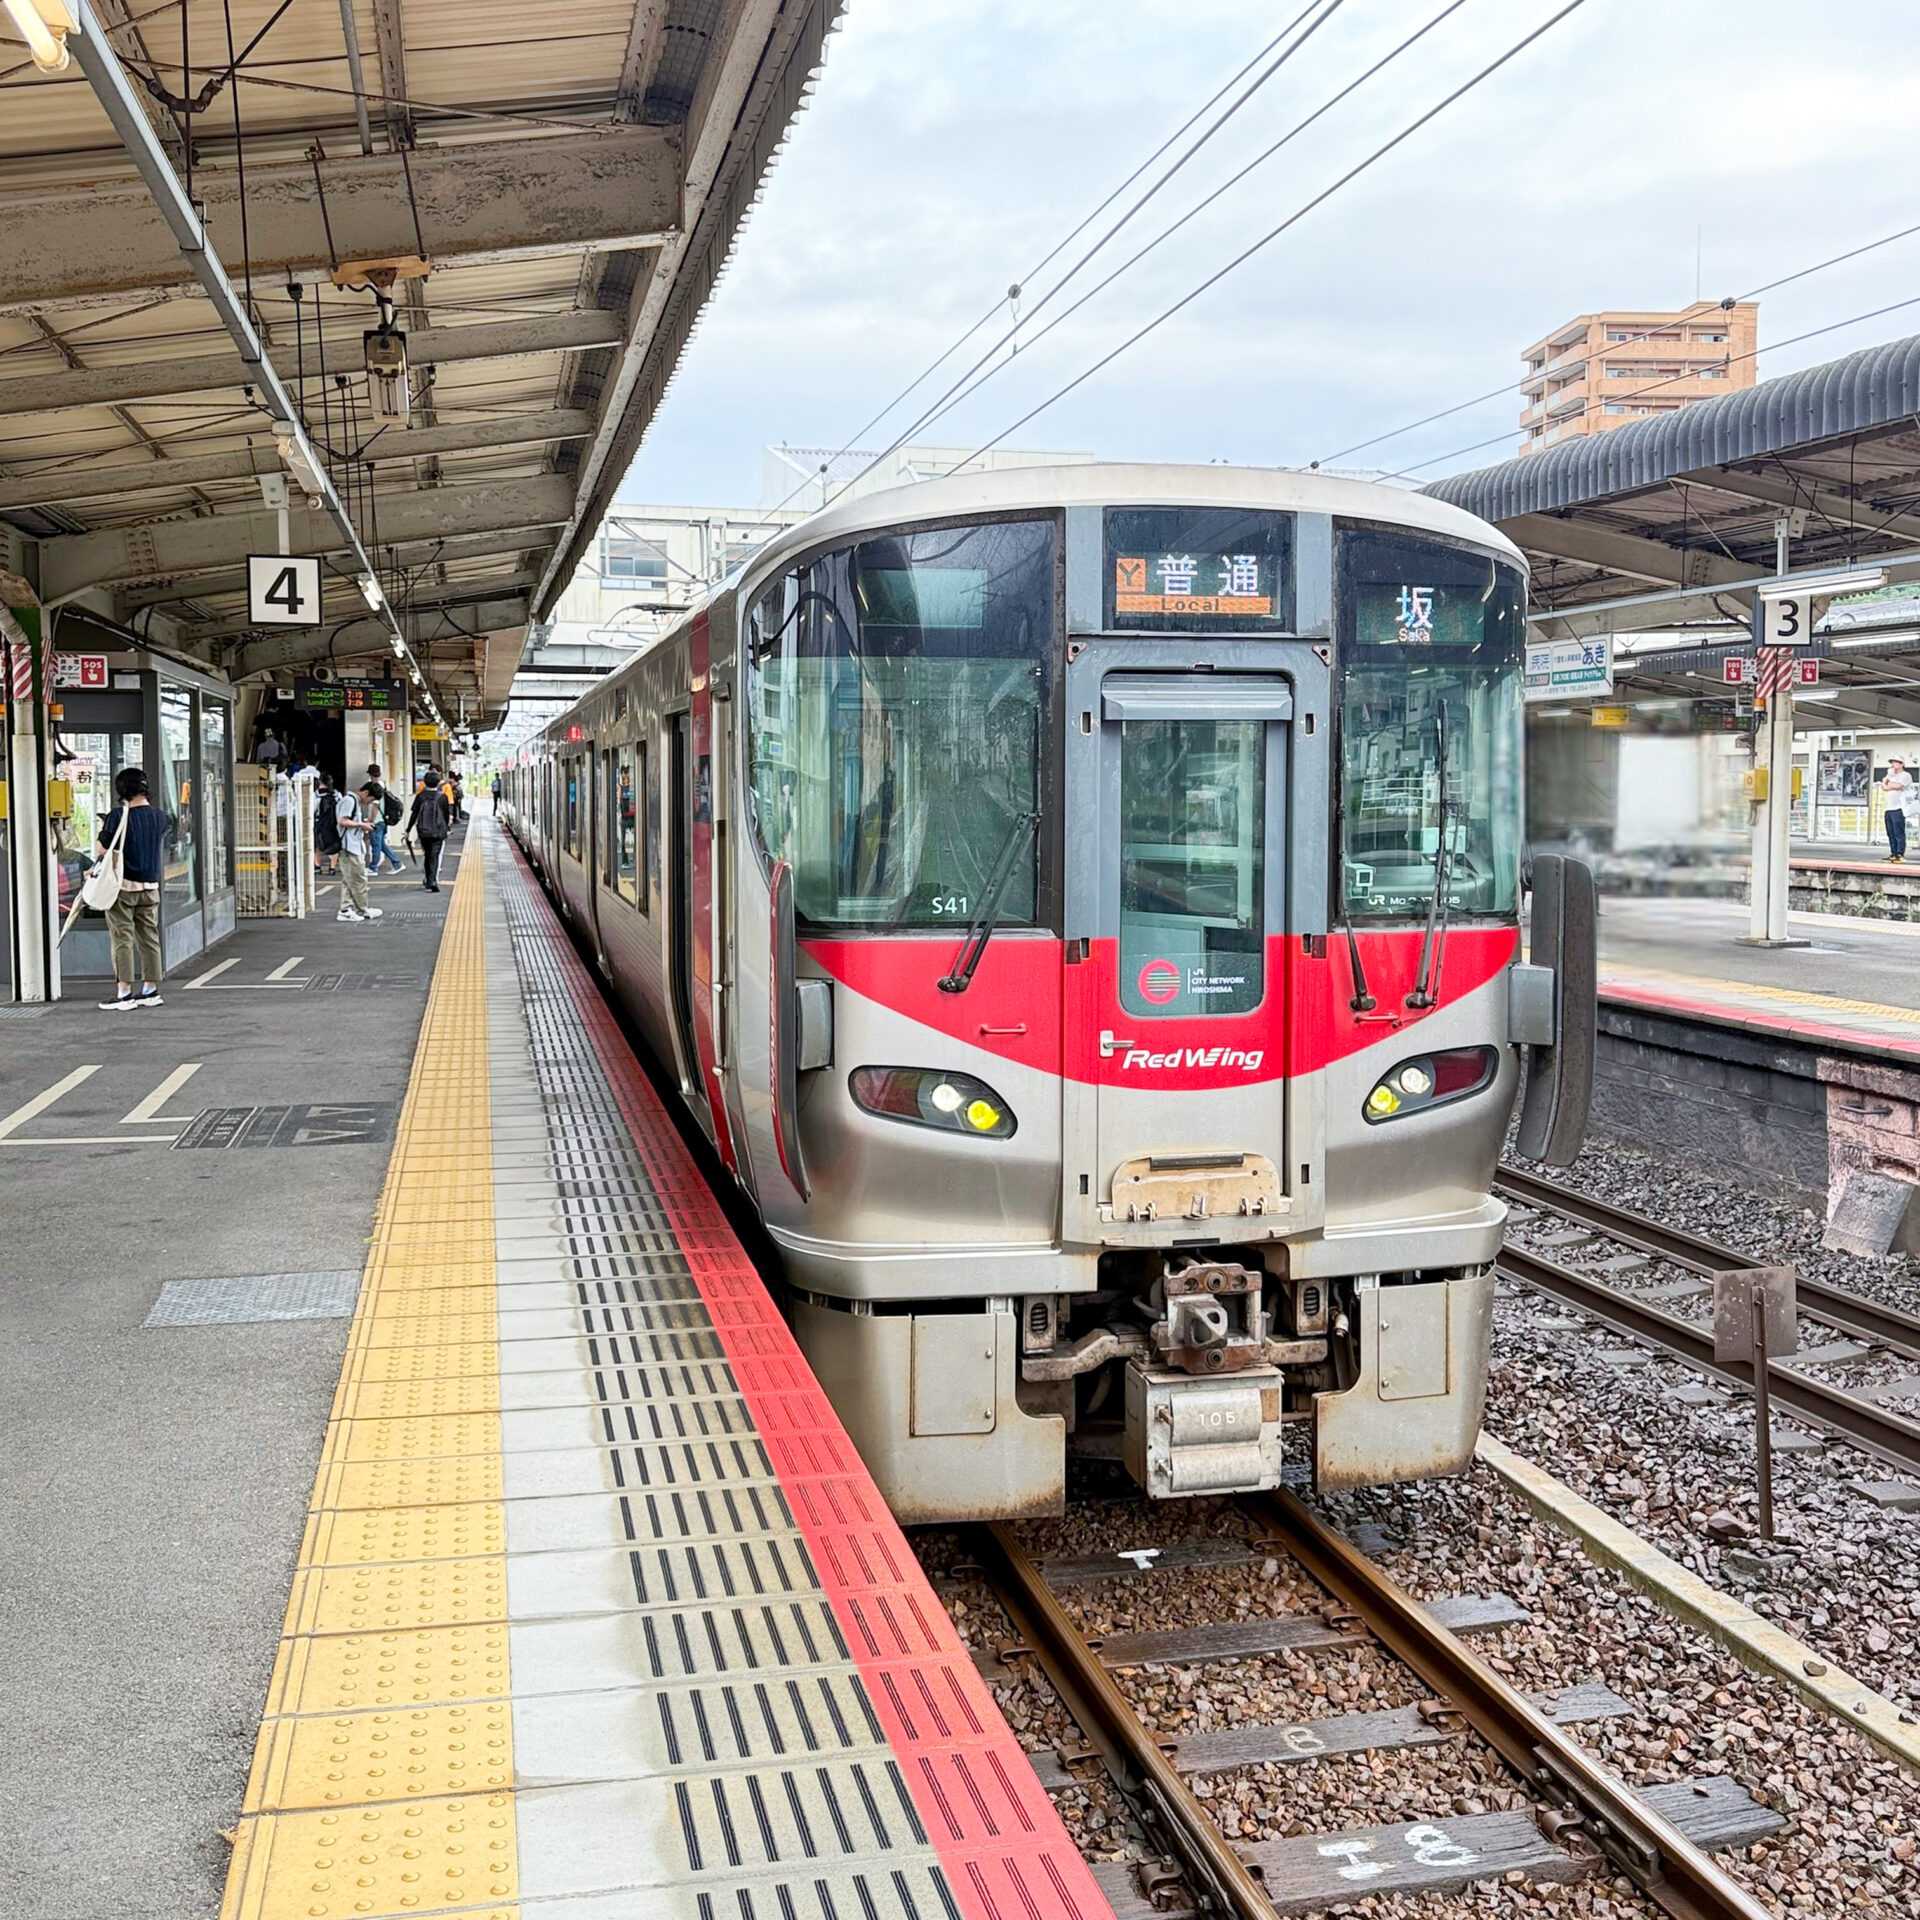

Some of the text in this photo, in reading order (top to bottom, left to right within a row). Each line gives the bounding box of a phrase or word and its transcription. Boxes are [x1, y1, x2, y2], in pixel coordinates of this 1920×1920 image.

[1118, 554, 1259, 596] Y 普通
[265, 567, 304, 614] 4
[1161, 598, 1220, 612] Local
[1394, 584, 1434, 628] 坂
[1777, 599, 1799, 637] 3
[1399, 628, 1431, 642] Saka
[1582, 644, 1605, 665] あき
[84, 661, 103, 669] SOS
[393, 680, 401, 688] 4
[932, 896, 968, 915] S41
[1368, 895, 1386, 906] JR
[1192, 968, 1205, 976] JR
[1191, 976, 1245, 985] CITY NETWORK
[1191, 986, 1233, 994] HIROSHIMA
[1199, 1411, 1236, 1427] 105
[1280, 1726, 1326, 1752] 8
